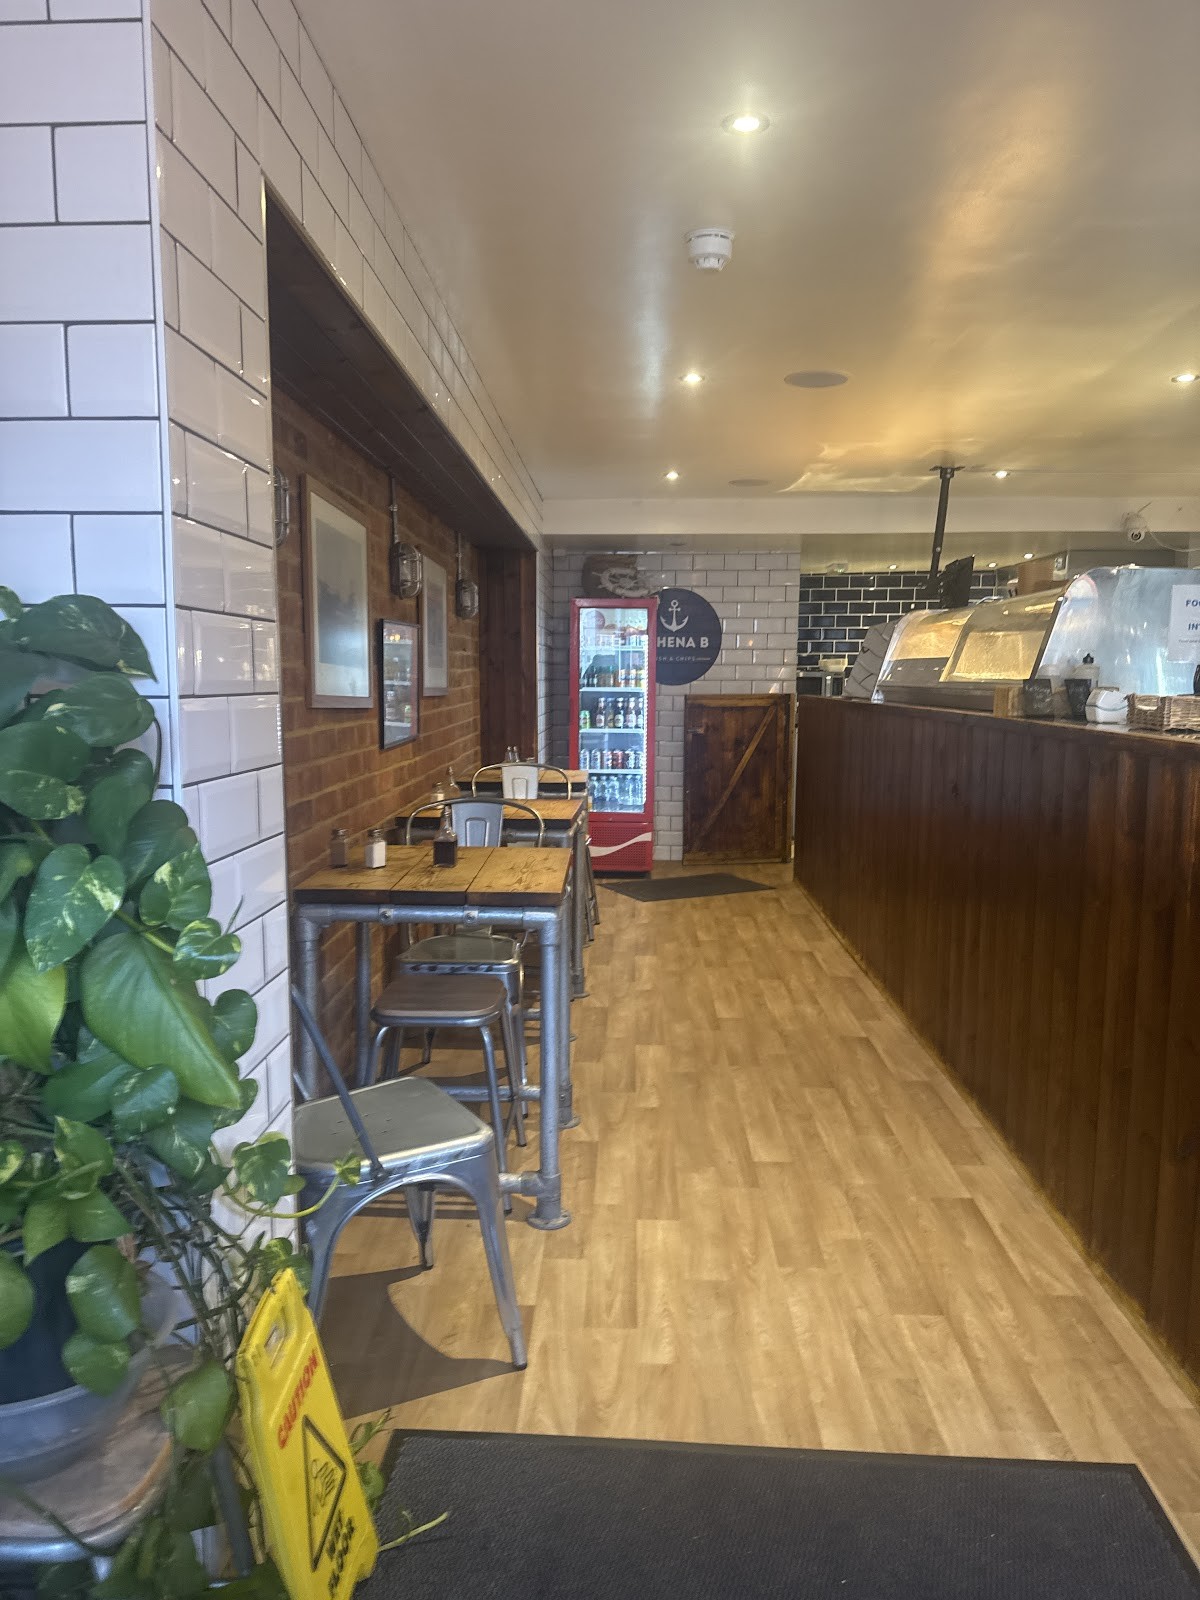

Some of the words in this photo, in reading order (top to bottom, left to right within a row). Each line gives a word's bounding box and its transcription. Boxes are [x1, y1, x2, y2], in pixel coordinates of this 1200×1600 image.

[1185, 599, 1200, 607] FO
[700, 636, 709, 648] B
[277, 1350, 319, 1450] CAUTION
